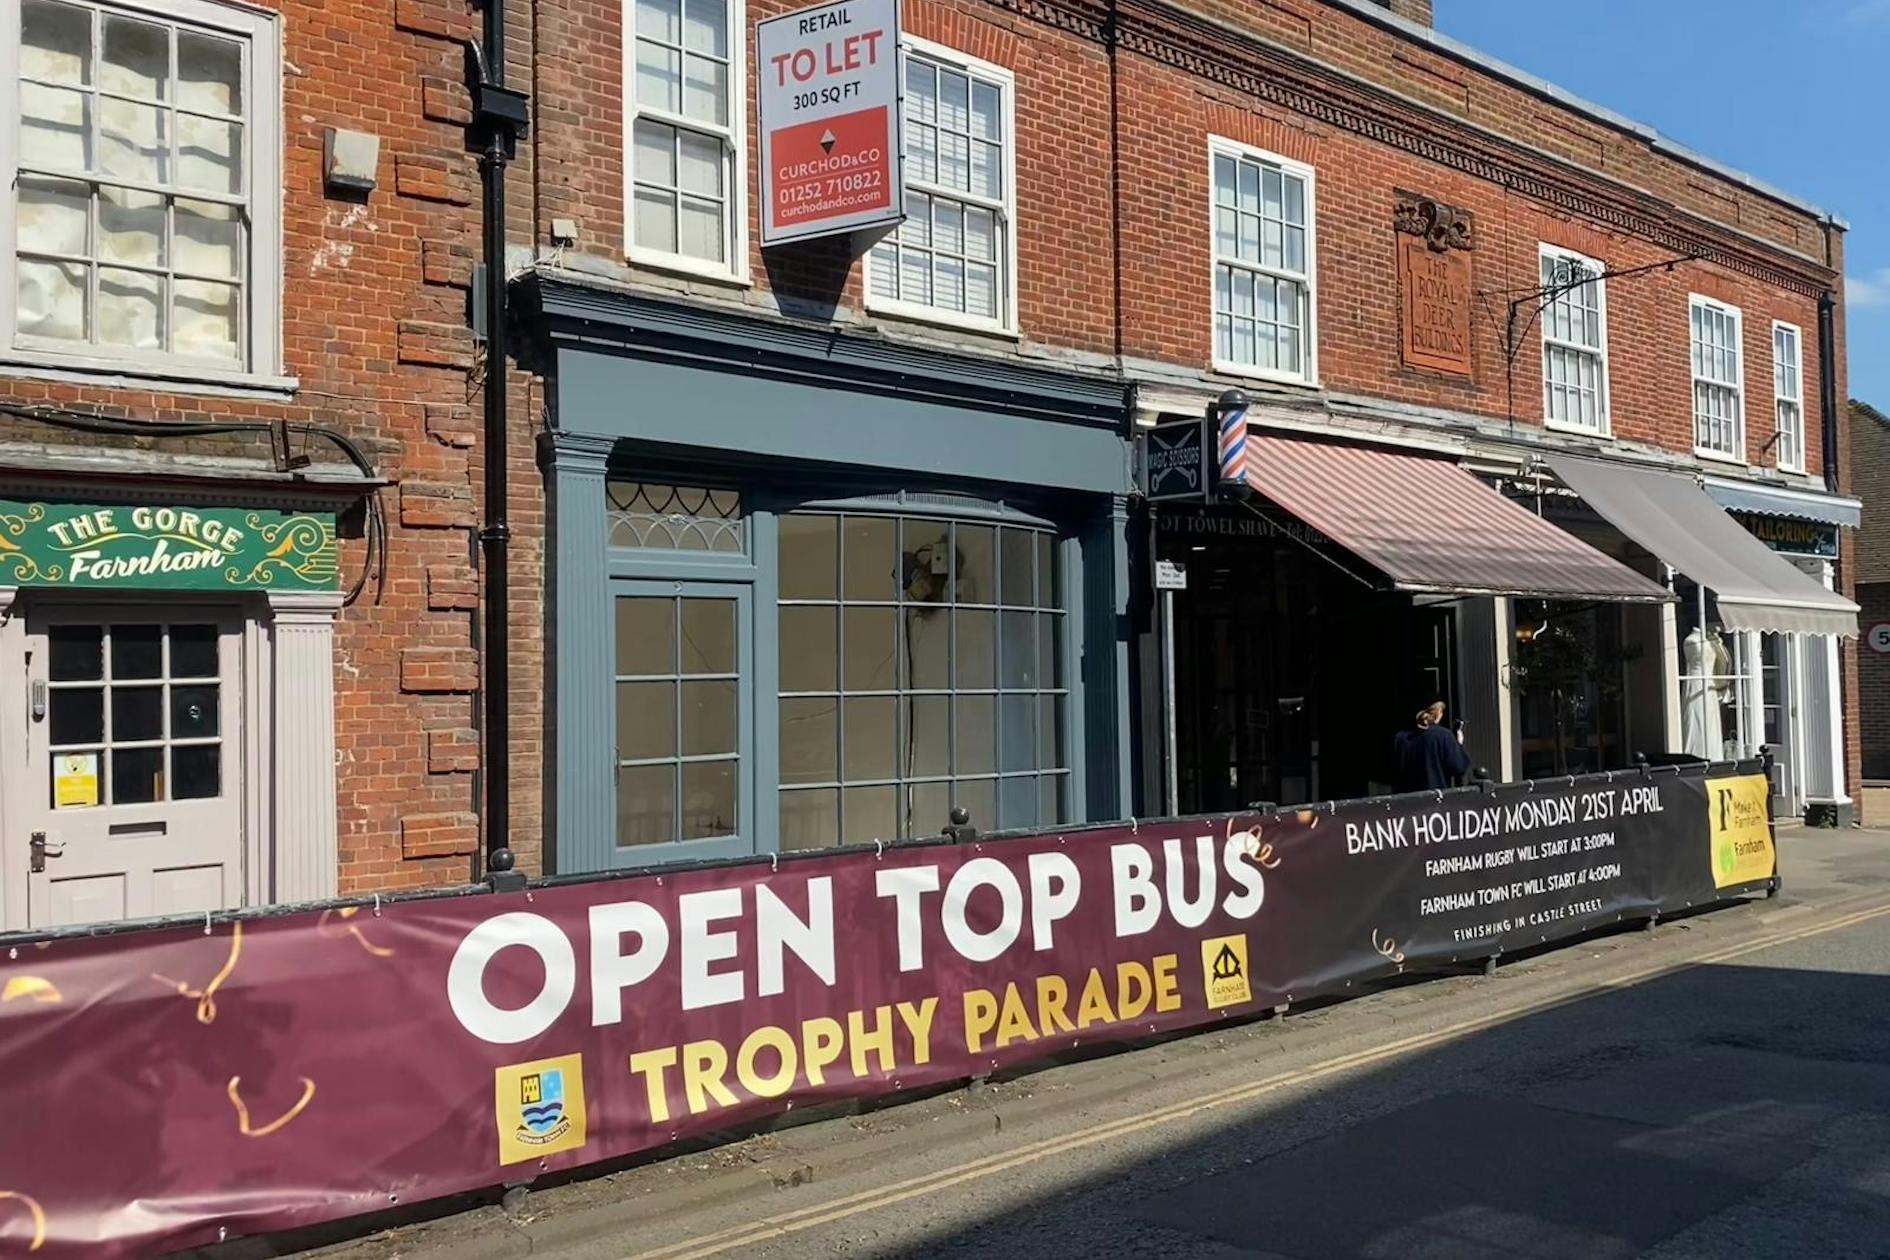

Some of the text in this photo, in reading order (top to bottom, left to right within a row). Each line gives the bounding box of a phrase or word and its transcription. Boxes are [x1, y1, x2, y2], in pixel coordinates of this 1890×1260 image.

[799, 8, 852, 36] RETAIL
[771, 30, 883, 87] TO LET
[793, 81, 861, 110] 300 SQ FT
[779, 148, 880, 180] CURCHOD&CO
[780, 170, 881, 204] 01252 710822
[781, 190, 881, 219] curchodandco.com
[1425, 257, 1448, 280] THE
[1418, 275, 1458, 305] ROYAL
[1423, 302, 1455, 330] DEER
[1414, 324, 1464, 354] BUILDINGS
[1169, 446, 1200, 466] SCISSORS
[47, 507, 244, 551] THE GORGE
[1185, 516, 1235, 535] TOWEL
[1239, 518, 1277, 537] SHAVE
[1751, 517, 1815, 543] TAILORING
[69, 539, 226, 582] Farnham
[1345, 786, 1664, 854] BANK HOLIDAY MONDAY 21ST APRIL
[1425, 831, 1615, 877] FARNHAM RUGBY WILL START AT 3:00PM
[1734, 838, 1766, 857] Farnham
[1420, 863, 1621, 916] FARNHAM TOWN FC WILL START AT 4:00PM
[1454, 898, 1603, 942] FINISHING IN CASTLE STREET
[447, 831, 1265, 1044] OPEN TOP BUS
[630, 953, 1182, 1124] TROPHY PARADE
